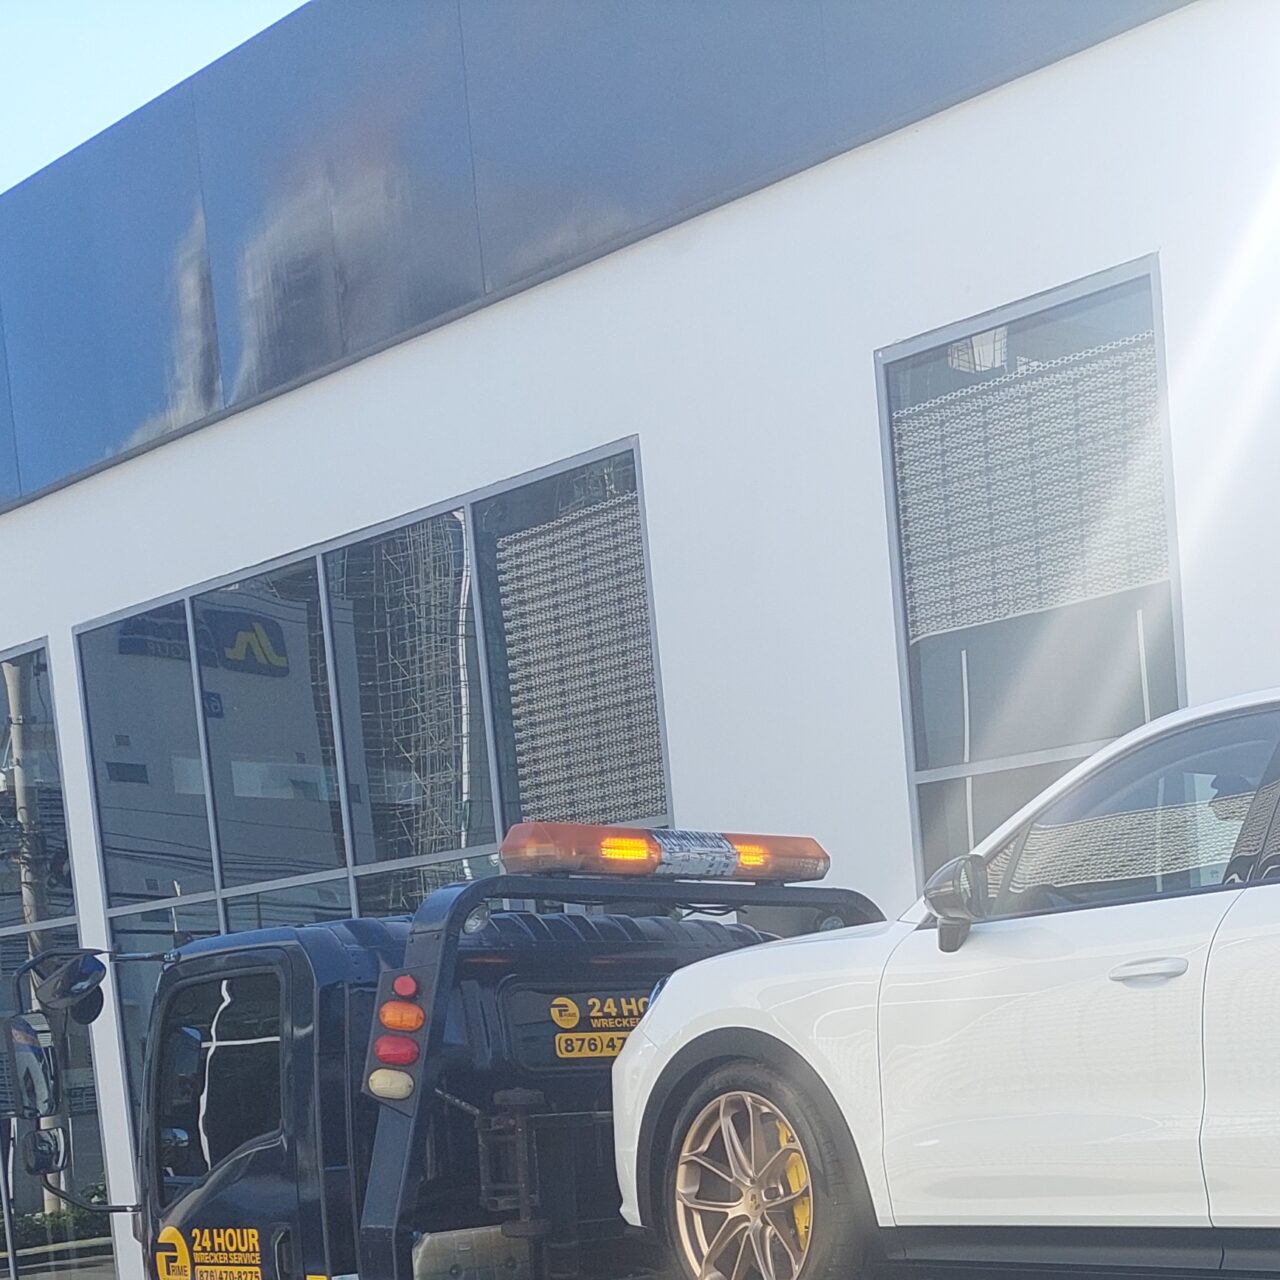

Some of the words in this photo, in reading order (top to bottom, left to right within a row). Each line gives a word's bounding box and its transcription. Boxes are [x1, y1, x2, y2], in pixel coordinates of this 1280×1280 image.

[587, 997, 618, 1017] 24
[620, 997, 649, 1017] HO
[558, 1035, 627, 1055] (876)47
[191, 1227, 211, 1252] 24
[213, 1227, 260, 1252] HOUR
[193, 1252, 229, 1264] WRECKER
[229, 1252, 261, 1265] SERVICE
